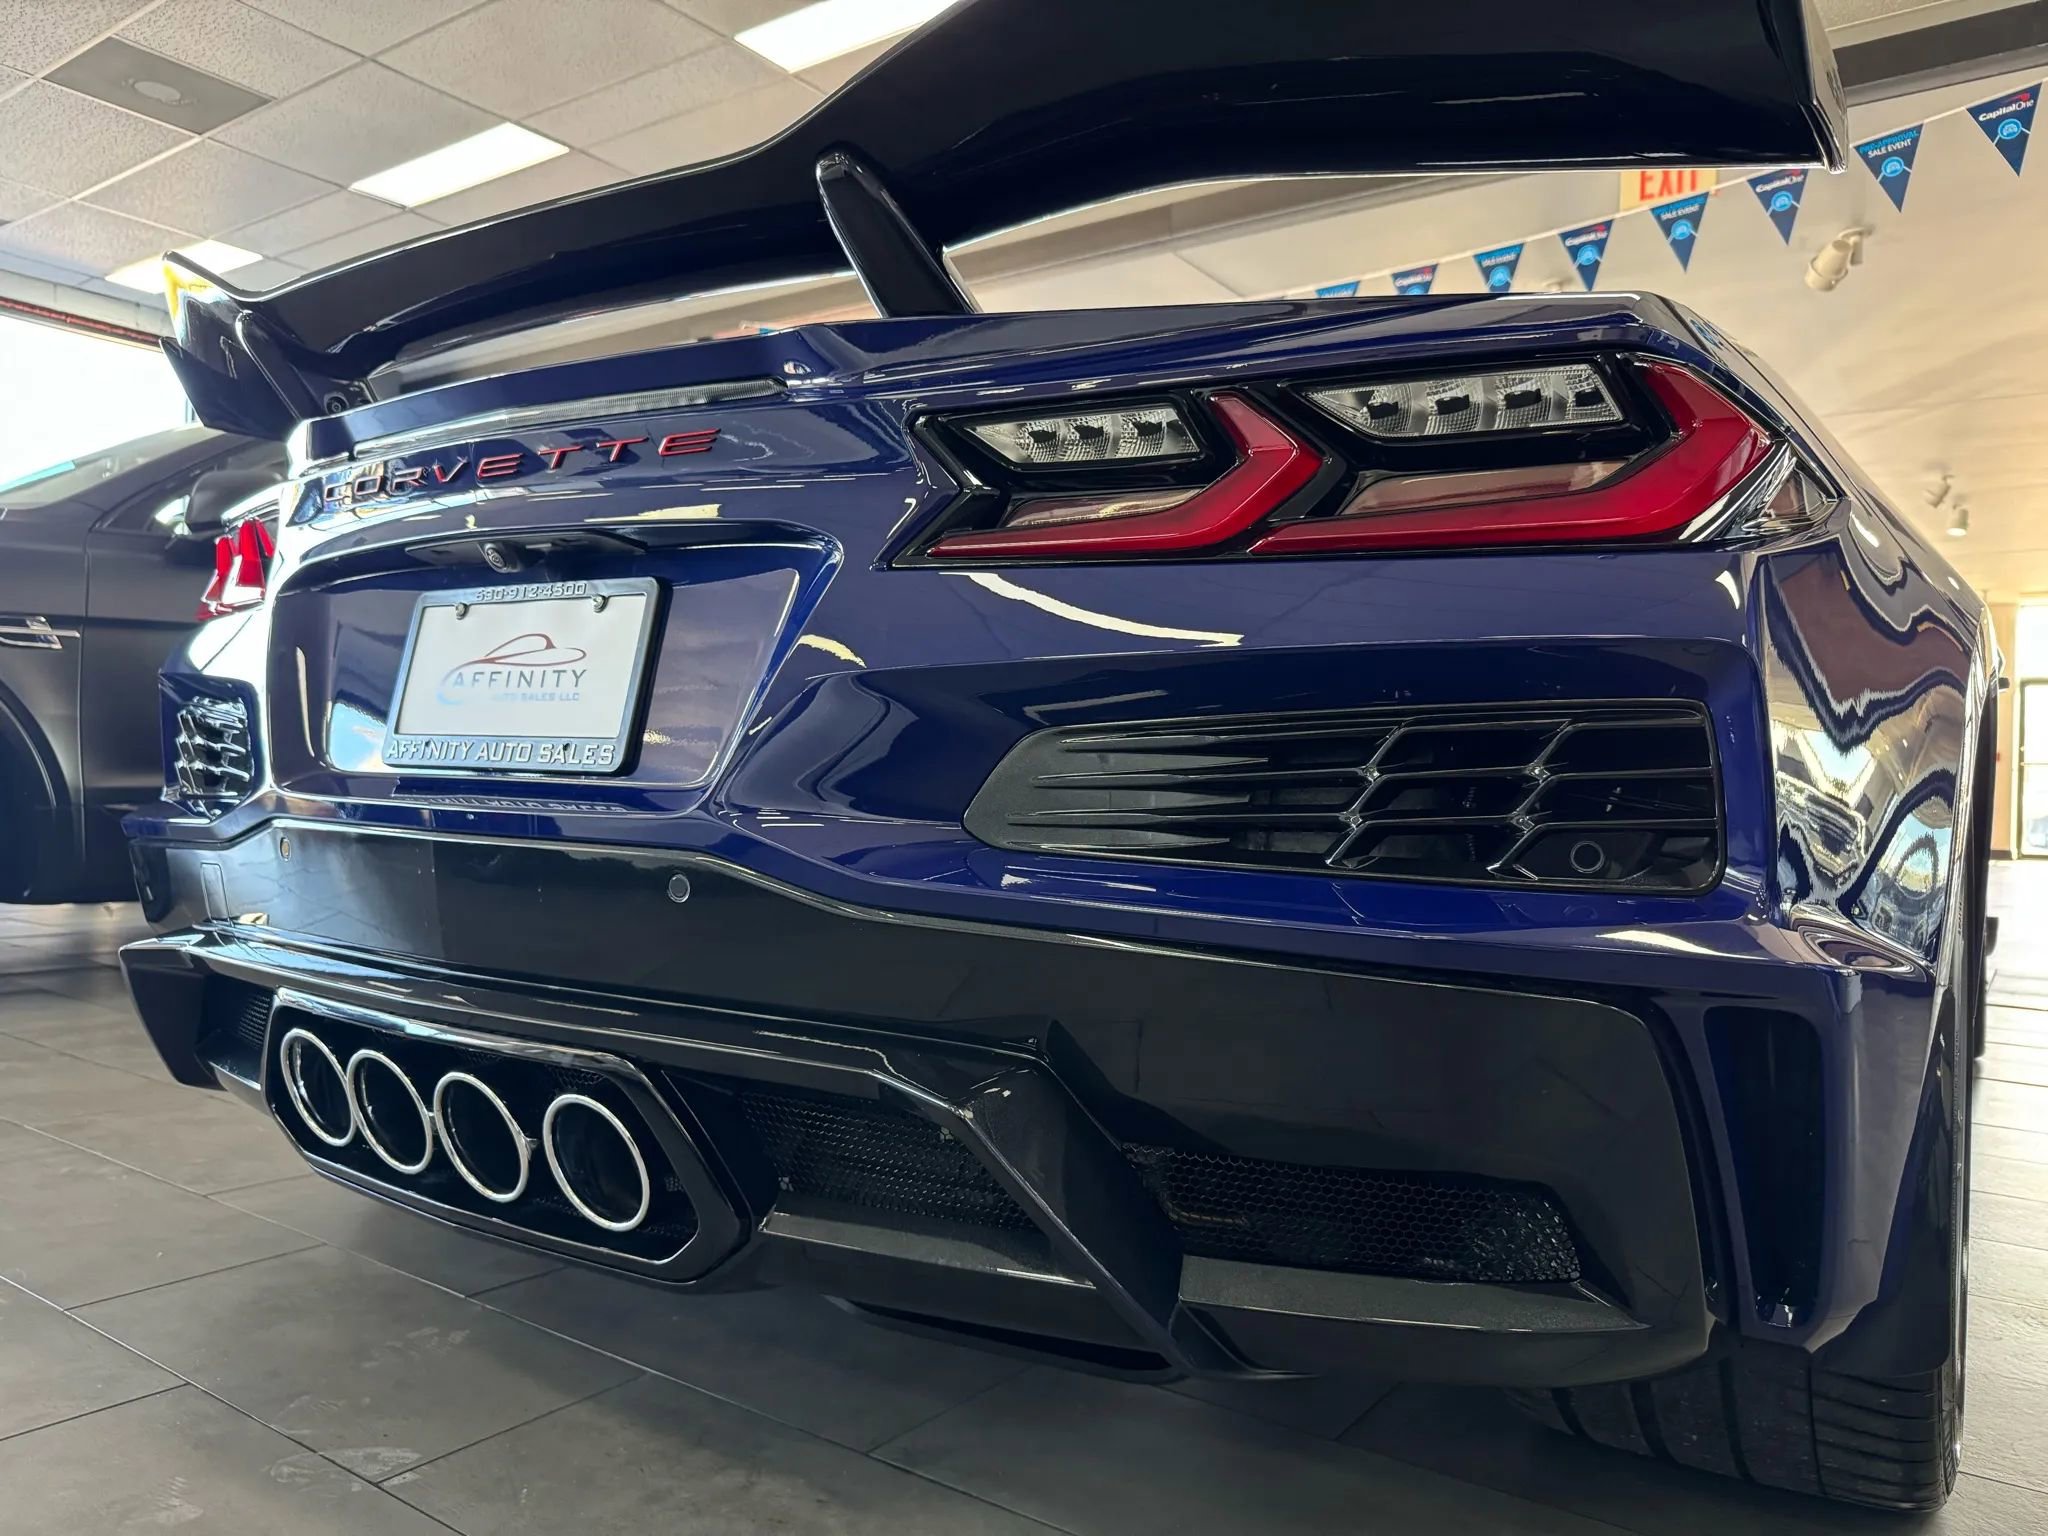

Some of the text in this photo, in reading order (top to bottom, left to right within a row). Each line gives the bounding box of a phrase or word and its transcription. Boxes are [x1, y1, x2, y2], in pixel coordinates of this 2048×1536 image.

[1868, 138, 1912, 159] SALE EVENT
[1639, 170, 1698, 202] EXIT
[323, 428, 722, 502] CORVETTE
[452, 669, 587, 689] AFFINITY
[559, 692, 580, 702] LLC
[386, 739, 616, 766] AFFINITY AUTO SALES
